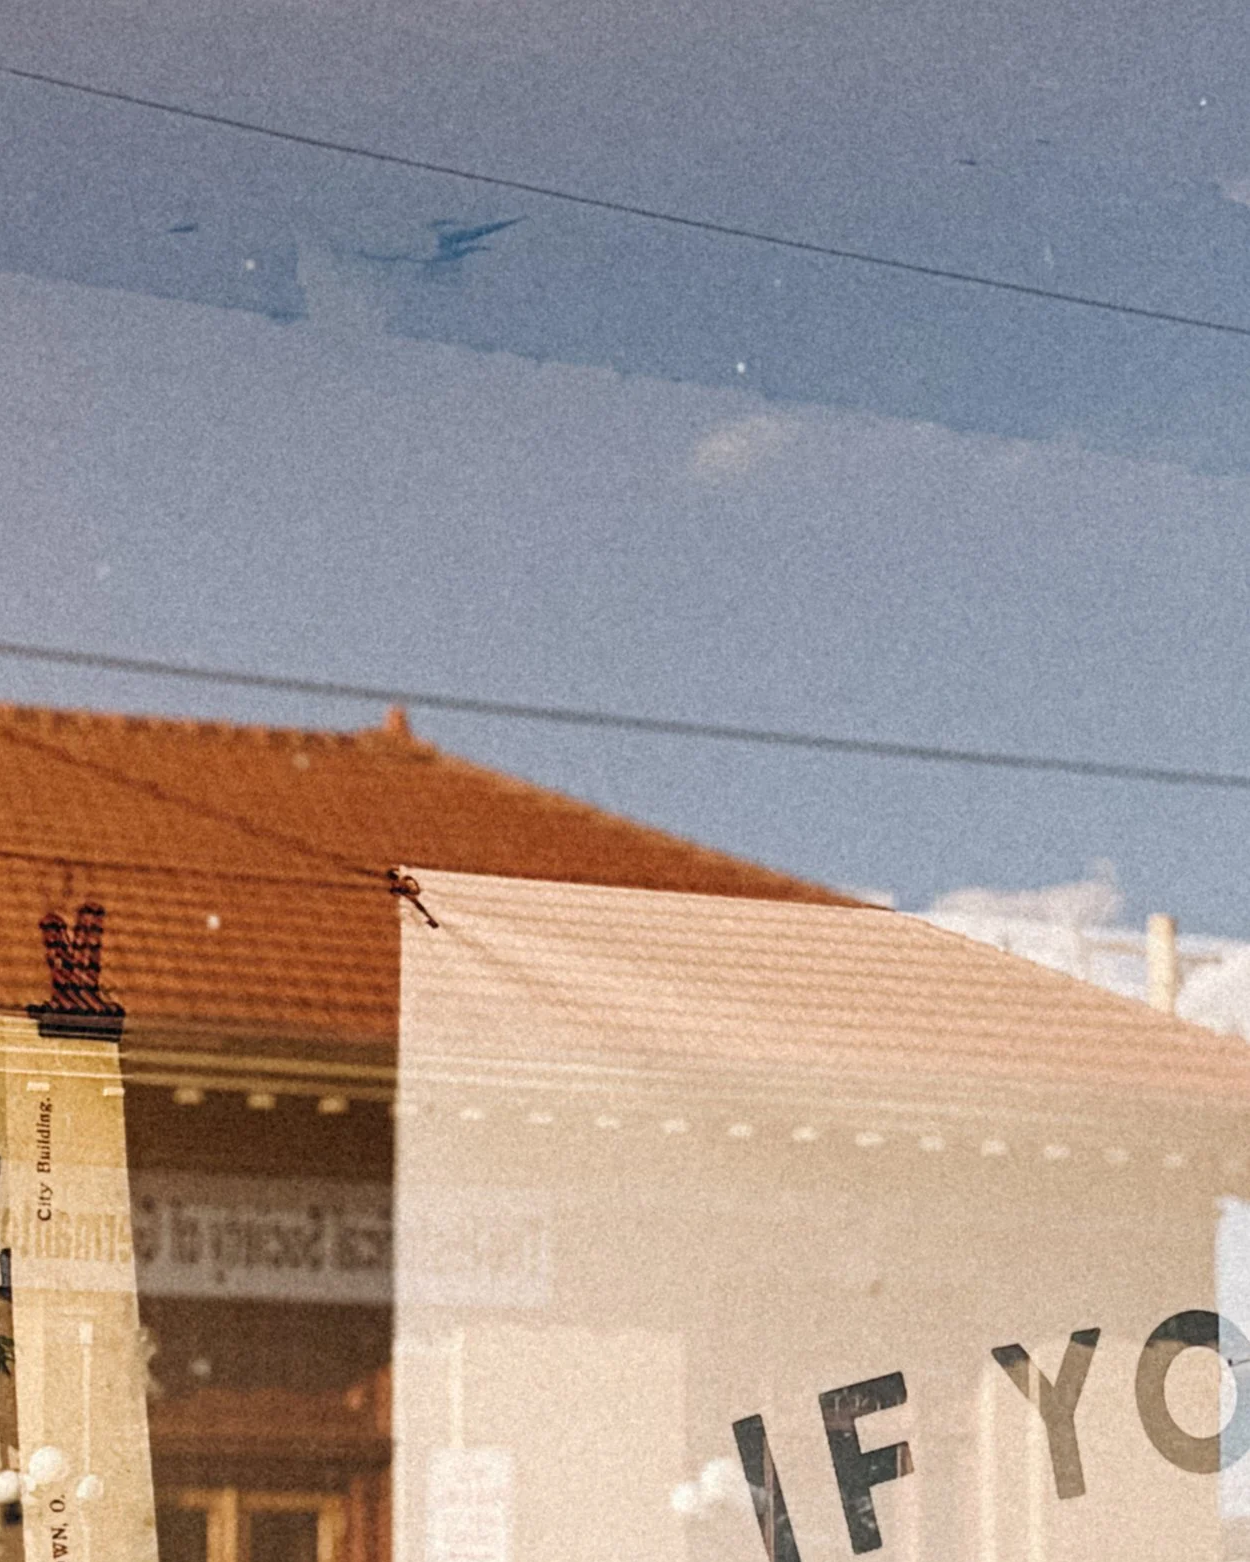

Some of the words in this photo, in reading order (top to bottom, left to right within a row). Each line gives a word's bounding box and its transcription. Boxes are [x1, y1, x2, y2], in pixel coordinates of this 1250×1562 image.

[36, 1097, 53, 1174] Building.
[36, 1182, 53, 1222] City
[990, 1309, 1250, 1500] YO
[49, 1493, 67, 1514] O.
